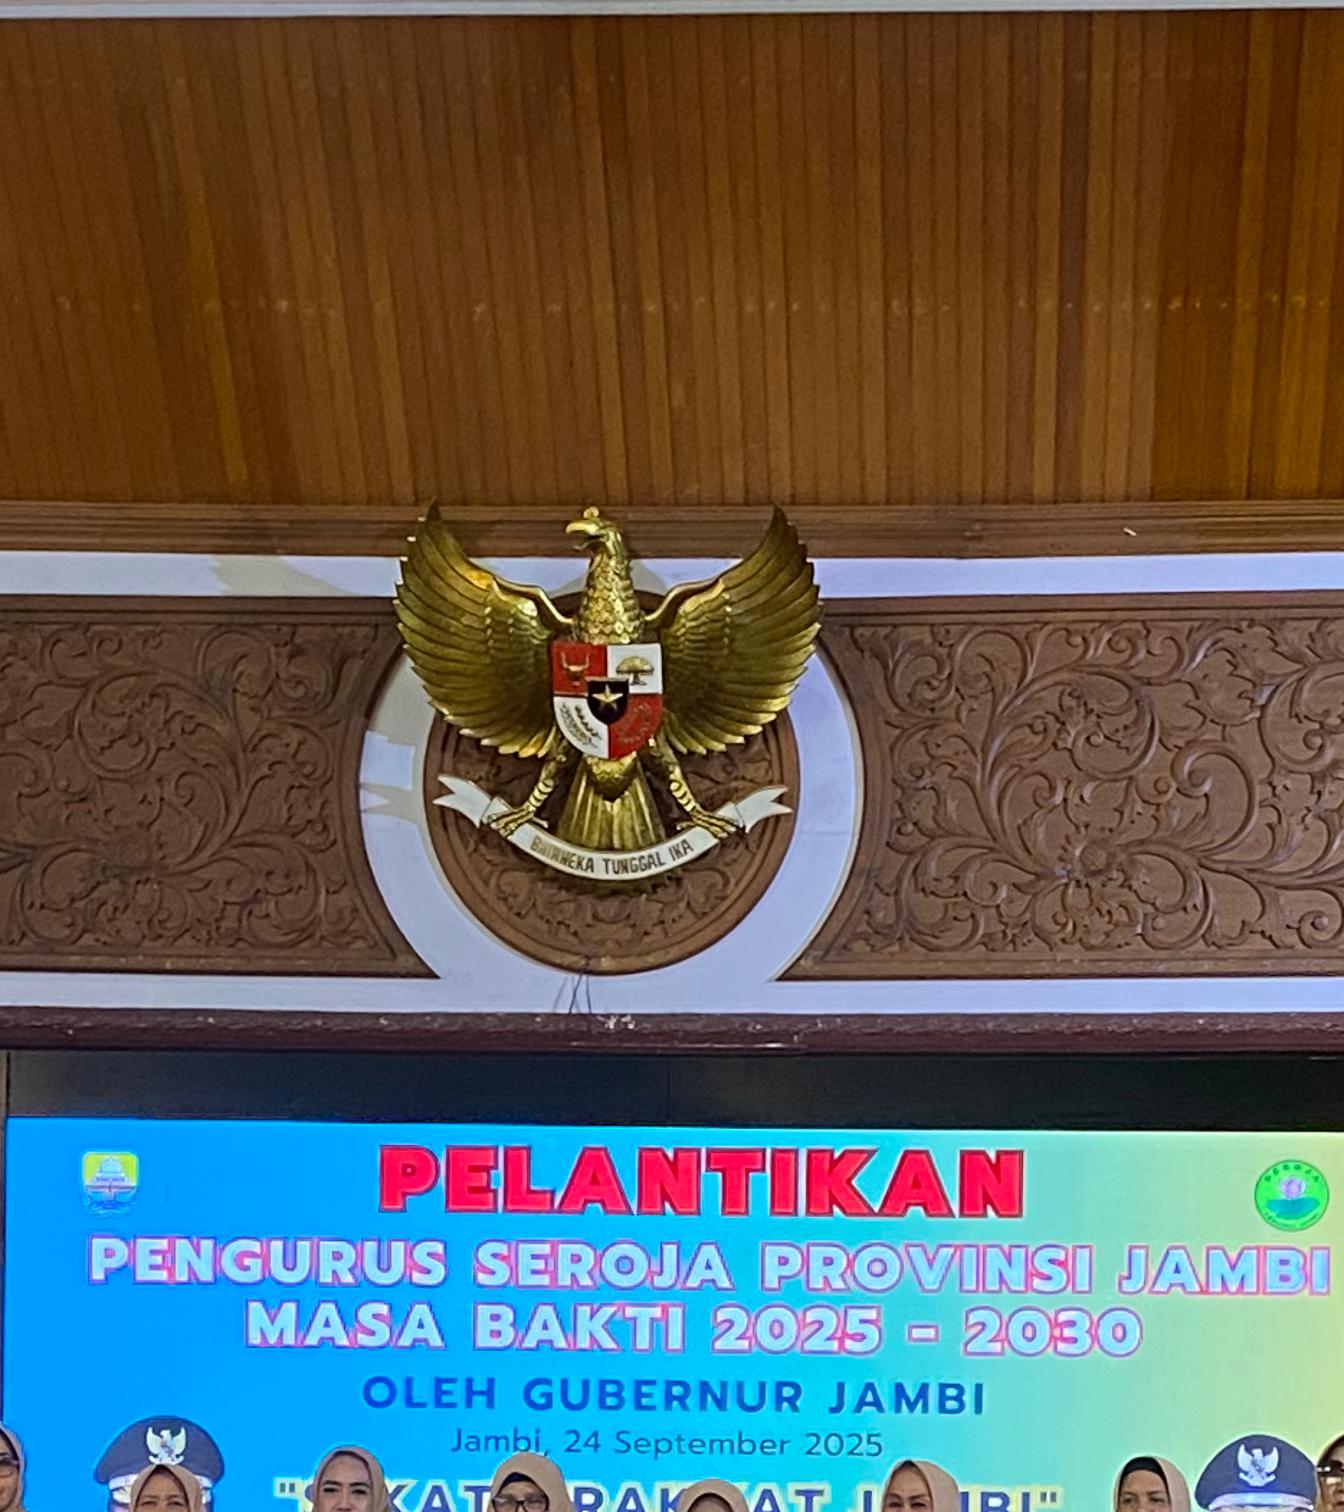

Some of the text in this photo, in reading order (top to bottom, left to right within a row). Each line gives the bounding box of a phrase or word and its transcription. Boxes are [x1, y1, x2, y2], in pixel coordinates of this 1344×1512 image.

[602, 853, 666, 875] TUNGGAL
[669, 838, 694, 862] IKA
[379, 1144, 1024, 1218] PELANTIKAN
[88, 1235, 1330, 1296] PENGURUS SEROJA PROVINSI JAMBI
[246, 1300, 1143, 1357] MASA BAKTI 2025 - 2030
[362, 1375, 984, 1416] OLEH GUBERNUR JAMBI
[451, 1427, 883, 1461] Jambi, 24 September 2025
